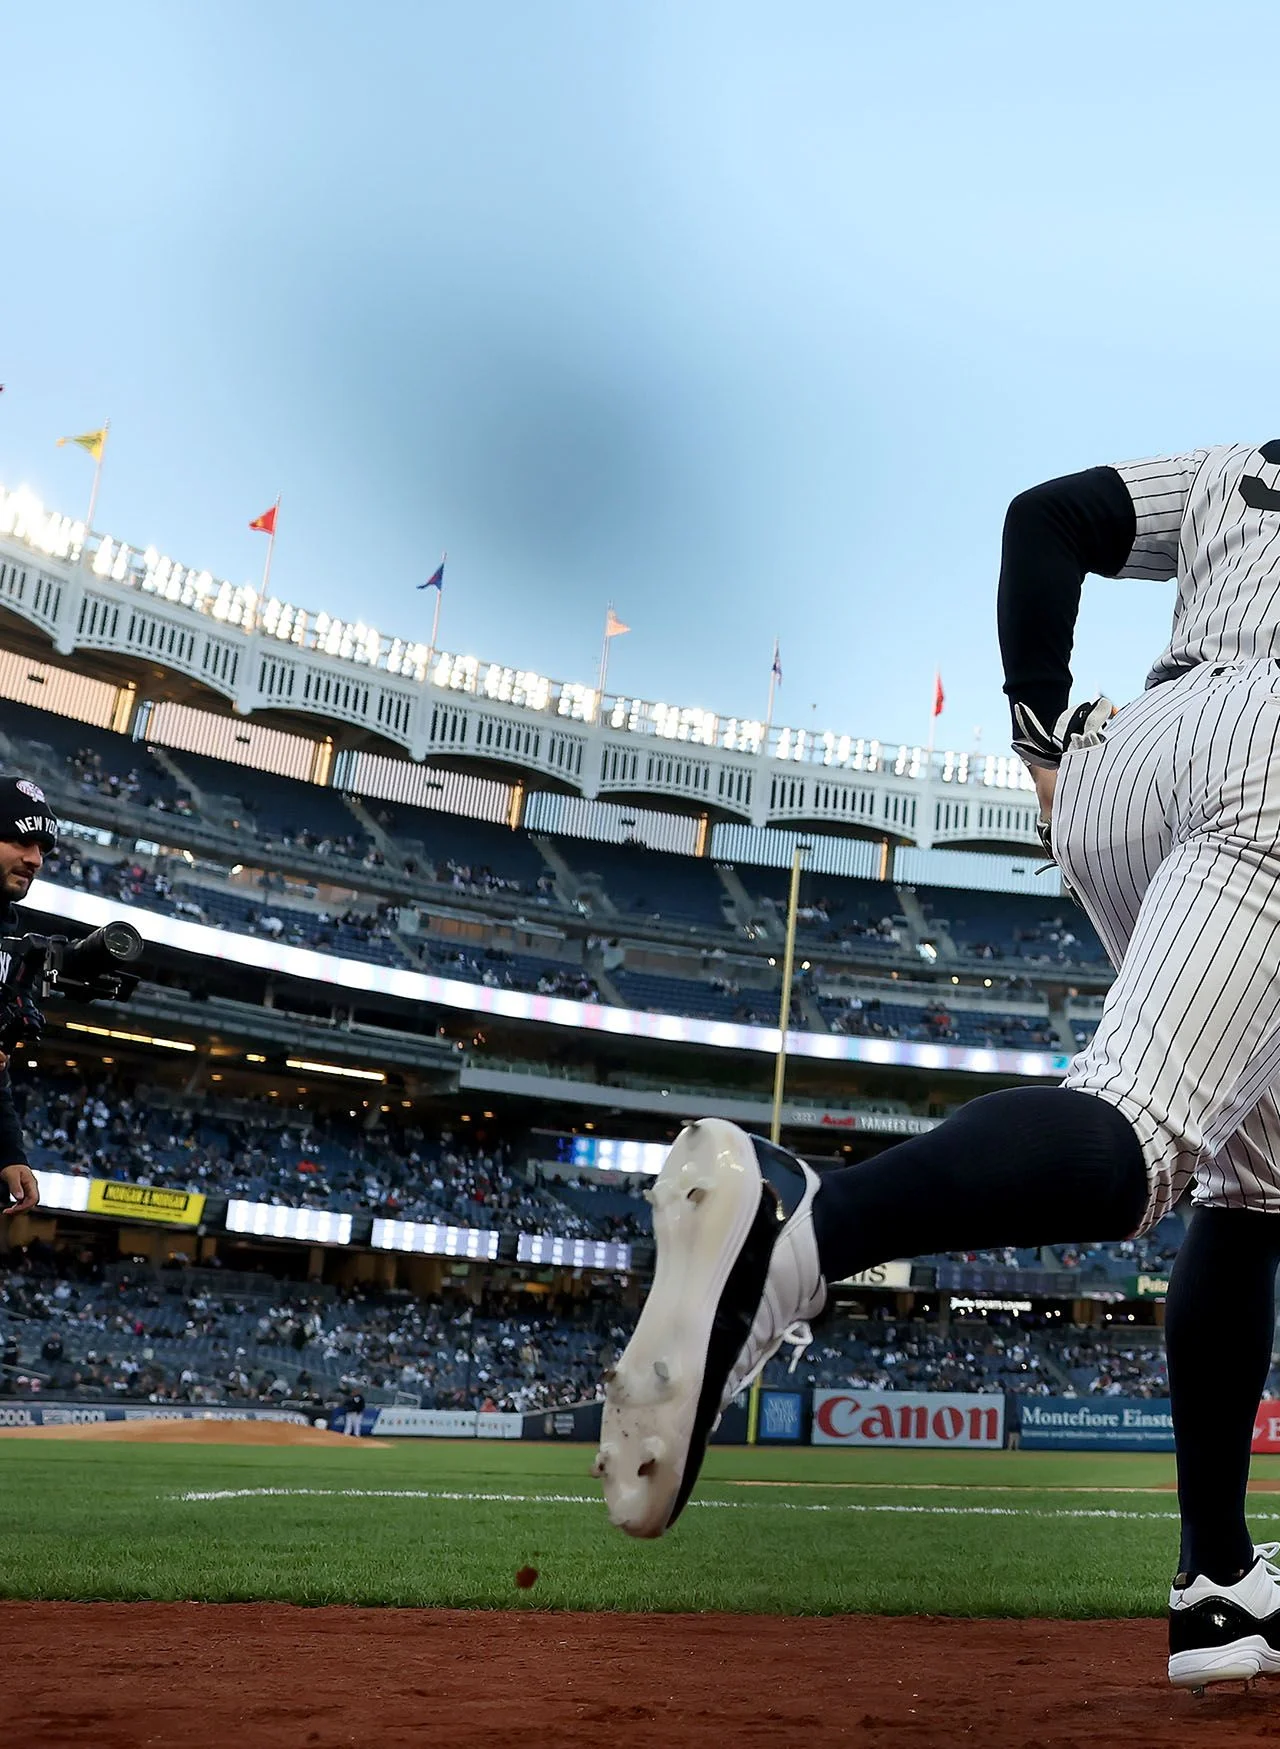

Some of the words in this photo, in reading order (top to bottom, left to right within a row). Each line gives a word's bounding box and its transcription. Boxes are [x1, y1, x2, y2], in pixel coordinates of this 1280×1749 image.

[15, 816, 43, 834] NEW
[817, 1396, 998, 1441] Canon
[1022, 1406, 1119, 1427] Montefiore
